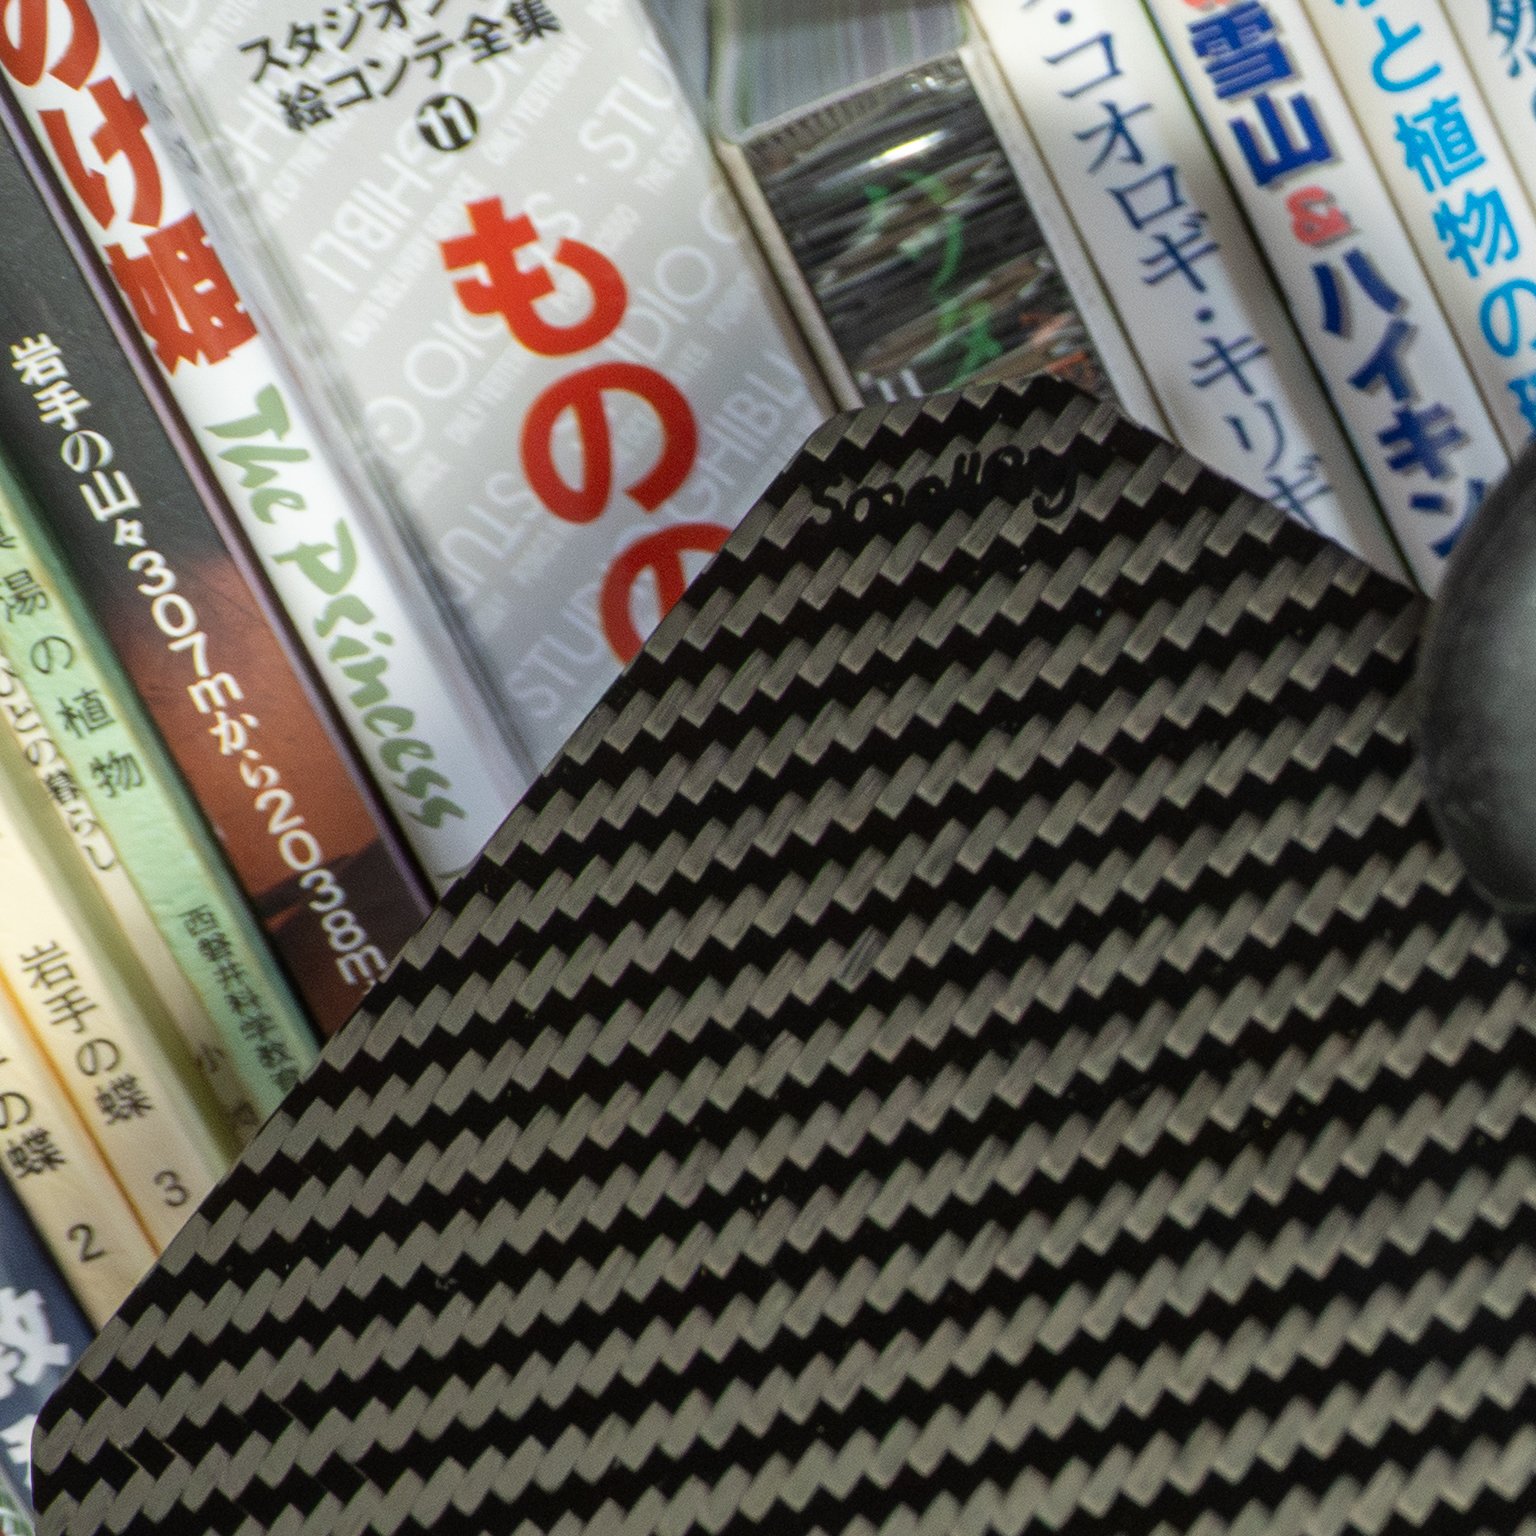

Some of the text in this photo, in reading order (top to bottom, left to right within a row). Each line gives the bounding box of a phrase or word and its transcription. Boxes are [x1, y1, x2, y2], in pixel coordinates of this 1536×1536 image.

[278, 0, 561, 132] 絵コンテ全集
[0, 515, 149, 799] 湯の植物
[205, 382, 311, 525] The
[273, 518, 467, 831] Princess
[20, 939, 191, 1208] 岩手の蝶 3
[66, 1223, 106, 1264] 2
